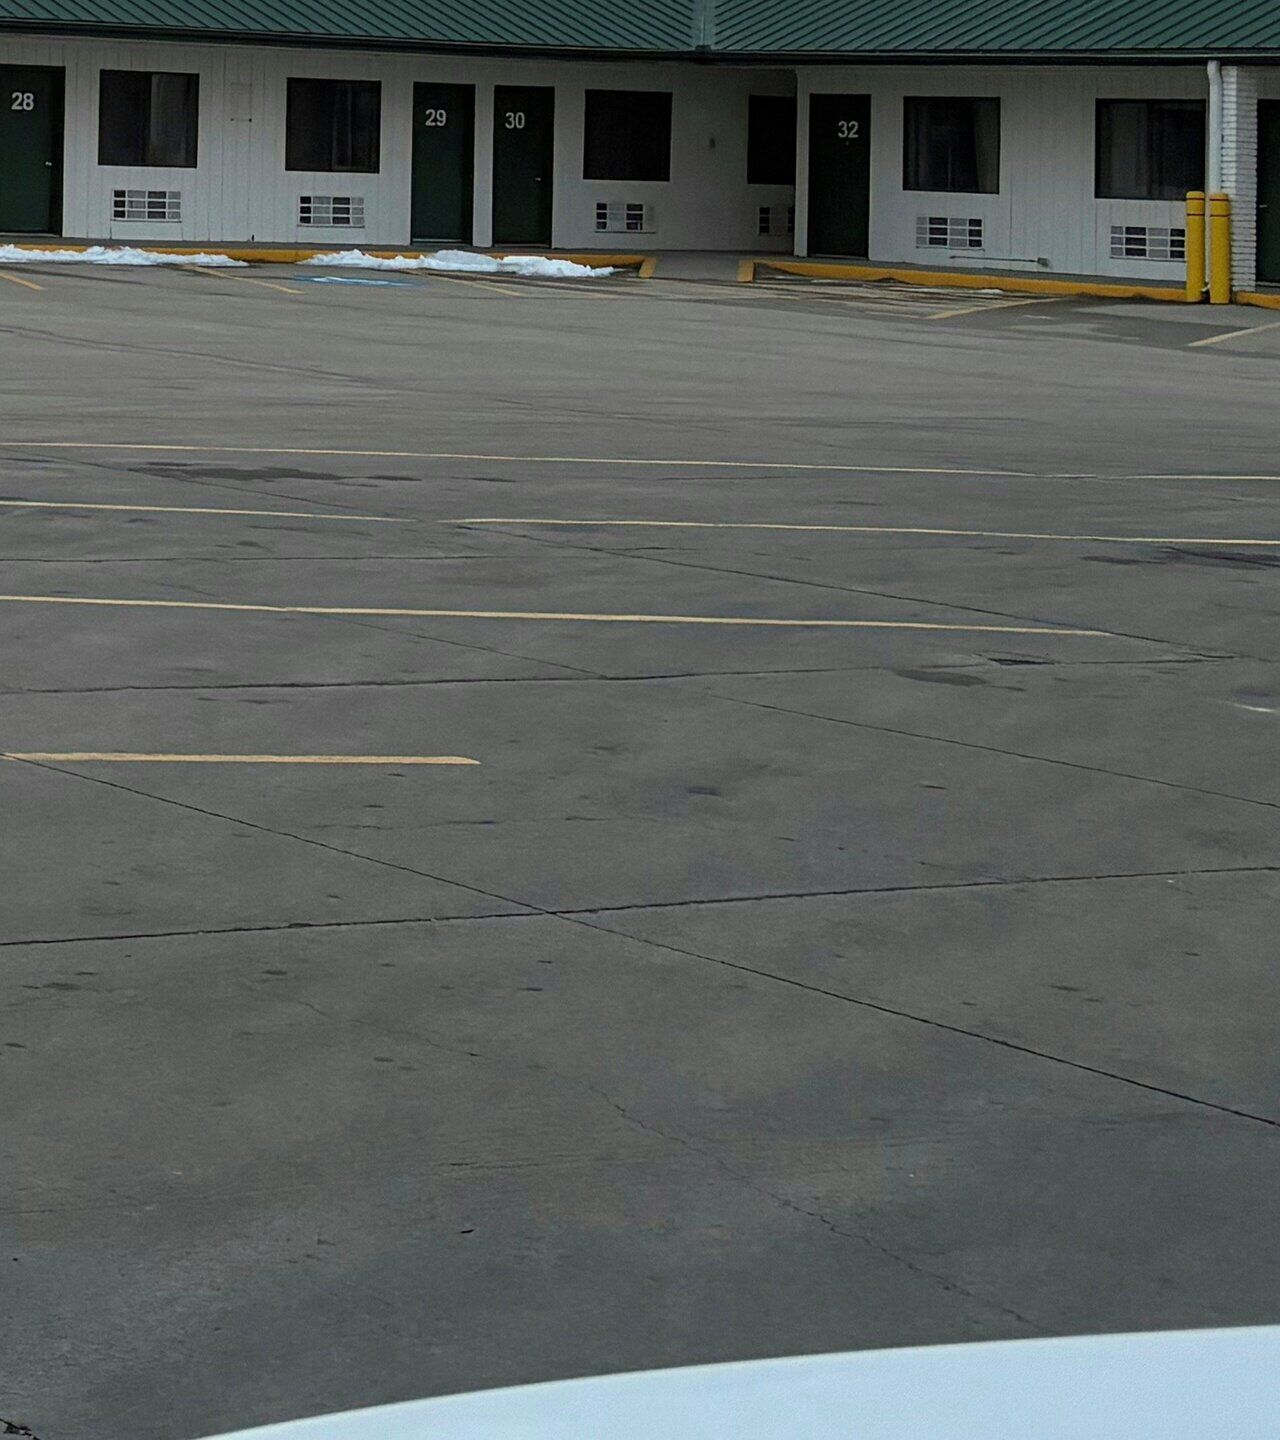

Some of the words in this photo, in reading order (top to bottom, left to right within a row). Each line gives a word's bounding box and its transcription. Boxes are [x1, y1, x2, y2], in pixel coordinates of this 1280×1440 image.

[11, 91, 35, 111] 28
[425, 108, 447, 127] 29
[505, 111, 525, 129] 30
[837, 120, 859, 138] 32
